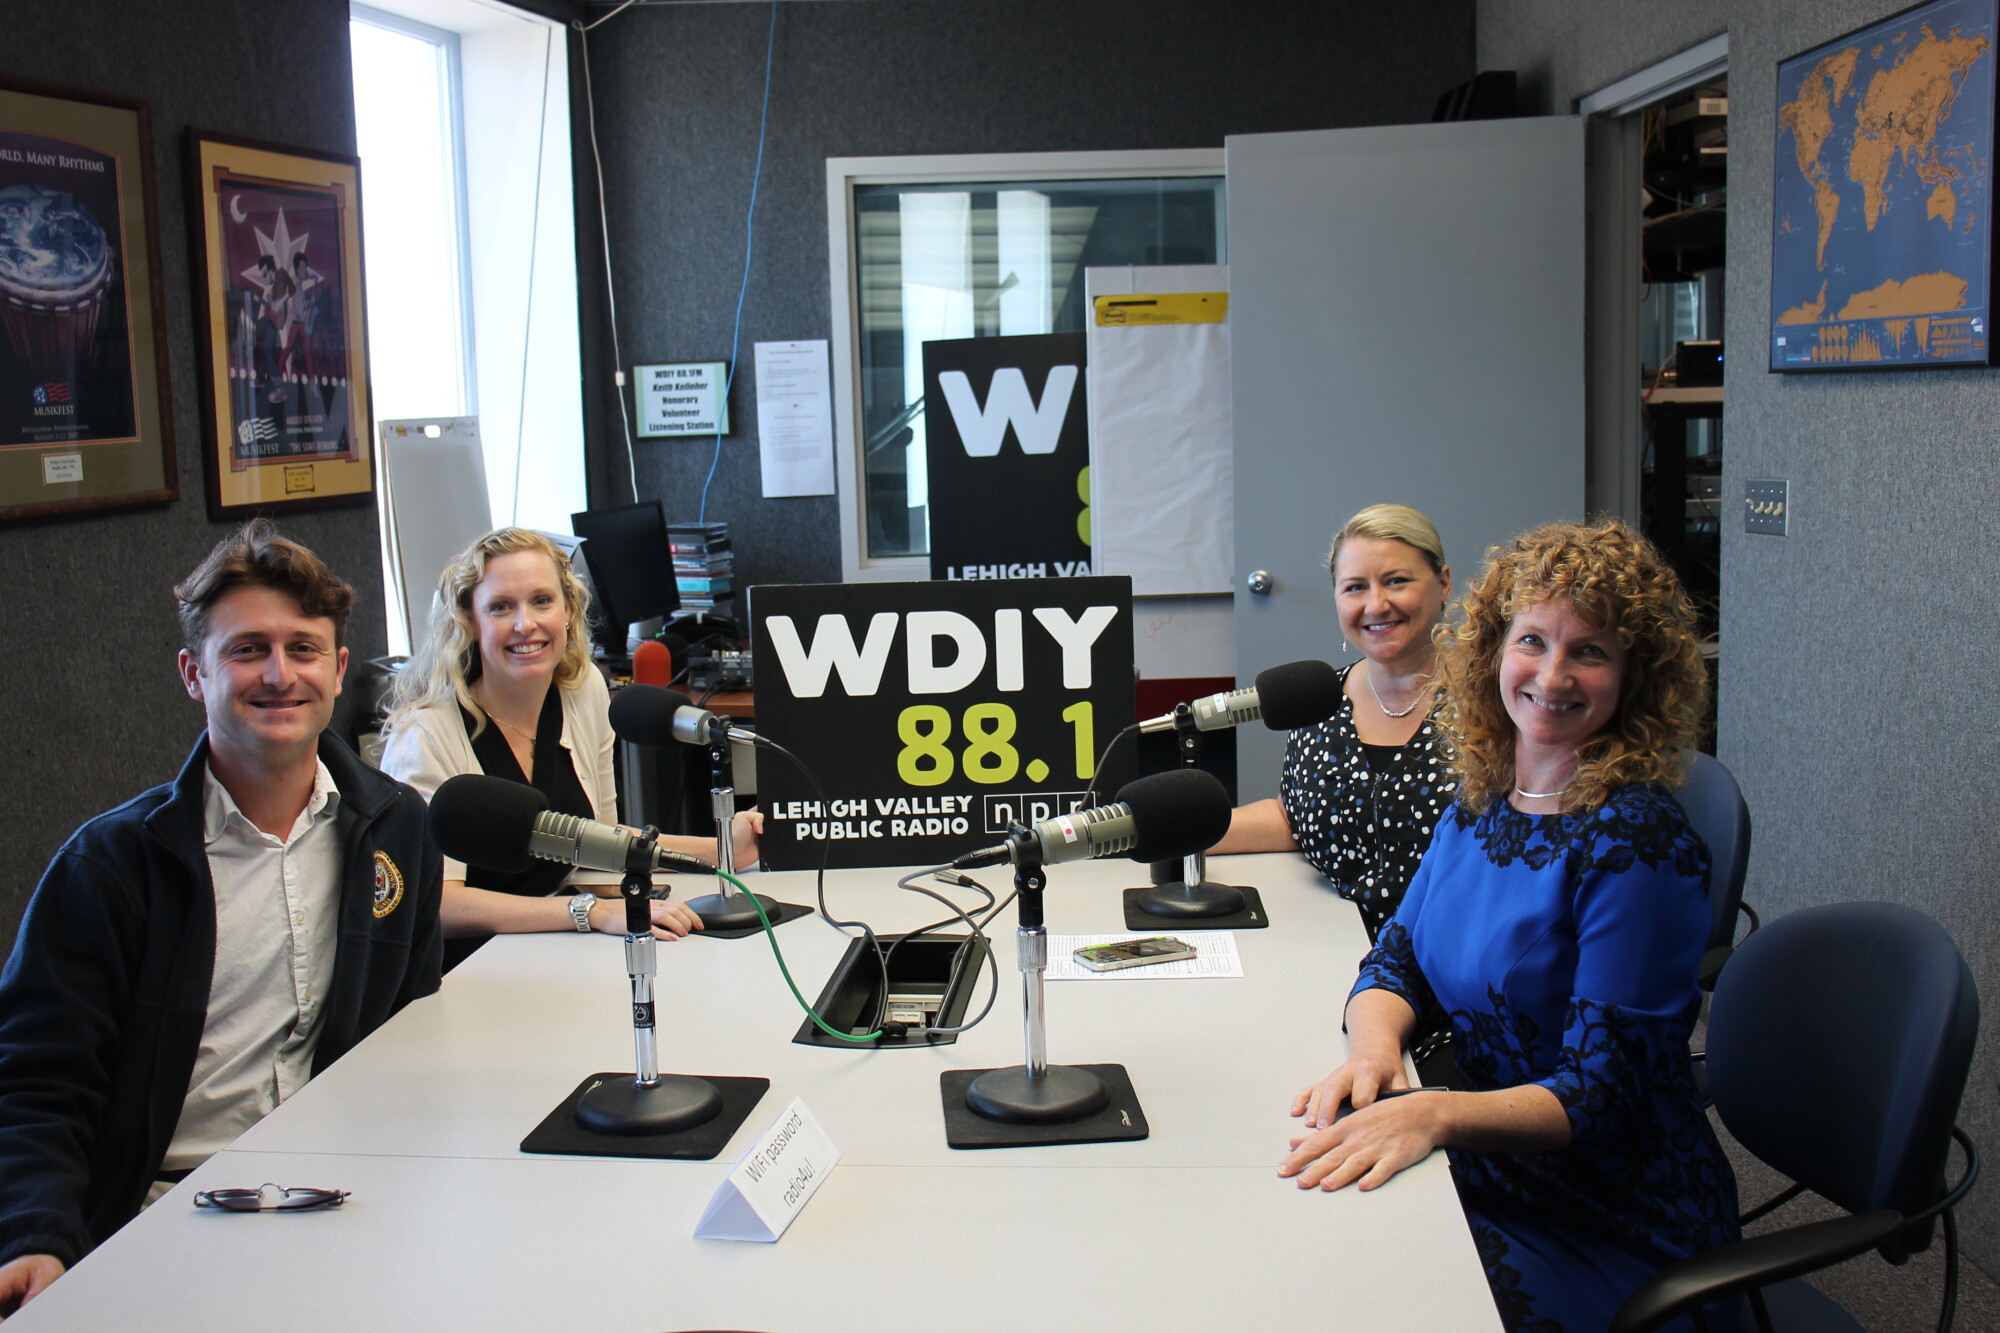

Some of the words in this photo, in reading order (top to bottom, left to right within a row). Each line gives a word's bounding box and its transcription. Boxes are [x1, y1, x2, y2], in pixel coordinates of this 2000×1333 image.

[0, 149, 24, 163] RLD,
[27, 151, 56, 166] MANY
[59, 155, 105, 172] RHYTHMS
[654, 370, 675, 379] WDIY
[652, 383, 673, 392] Keith
[674, 382, 708, 391] Kelleher
[662, 396, 698, 405] Honorary
[34, 405, 75, 416] MUSIKFEST
[661, 409, 700, 418] Volunteer
[649, 422, 685, 432] Listening
[686, 421, 714, 430] Station
[240, 444, 279, 456] MUSIKFEST
[947, 562, 1047, 581] LEHIGH
[765, 605, 1119, 698] WDIY
[897, 701, 1094, 787] 88.1
[772, 798, 868, 820] LEHIGH
[874, 795, 973, 816] VALLEY
[796, 819, 883, 841] PUBLIC
[891, 816, 969, 837] RADIO
[744, 1152, 771, 1183] WiFi
[766, 1108, 803, 1166] password
[783, 1157, 816, 1208] radio4u!
